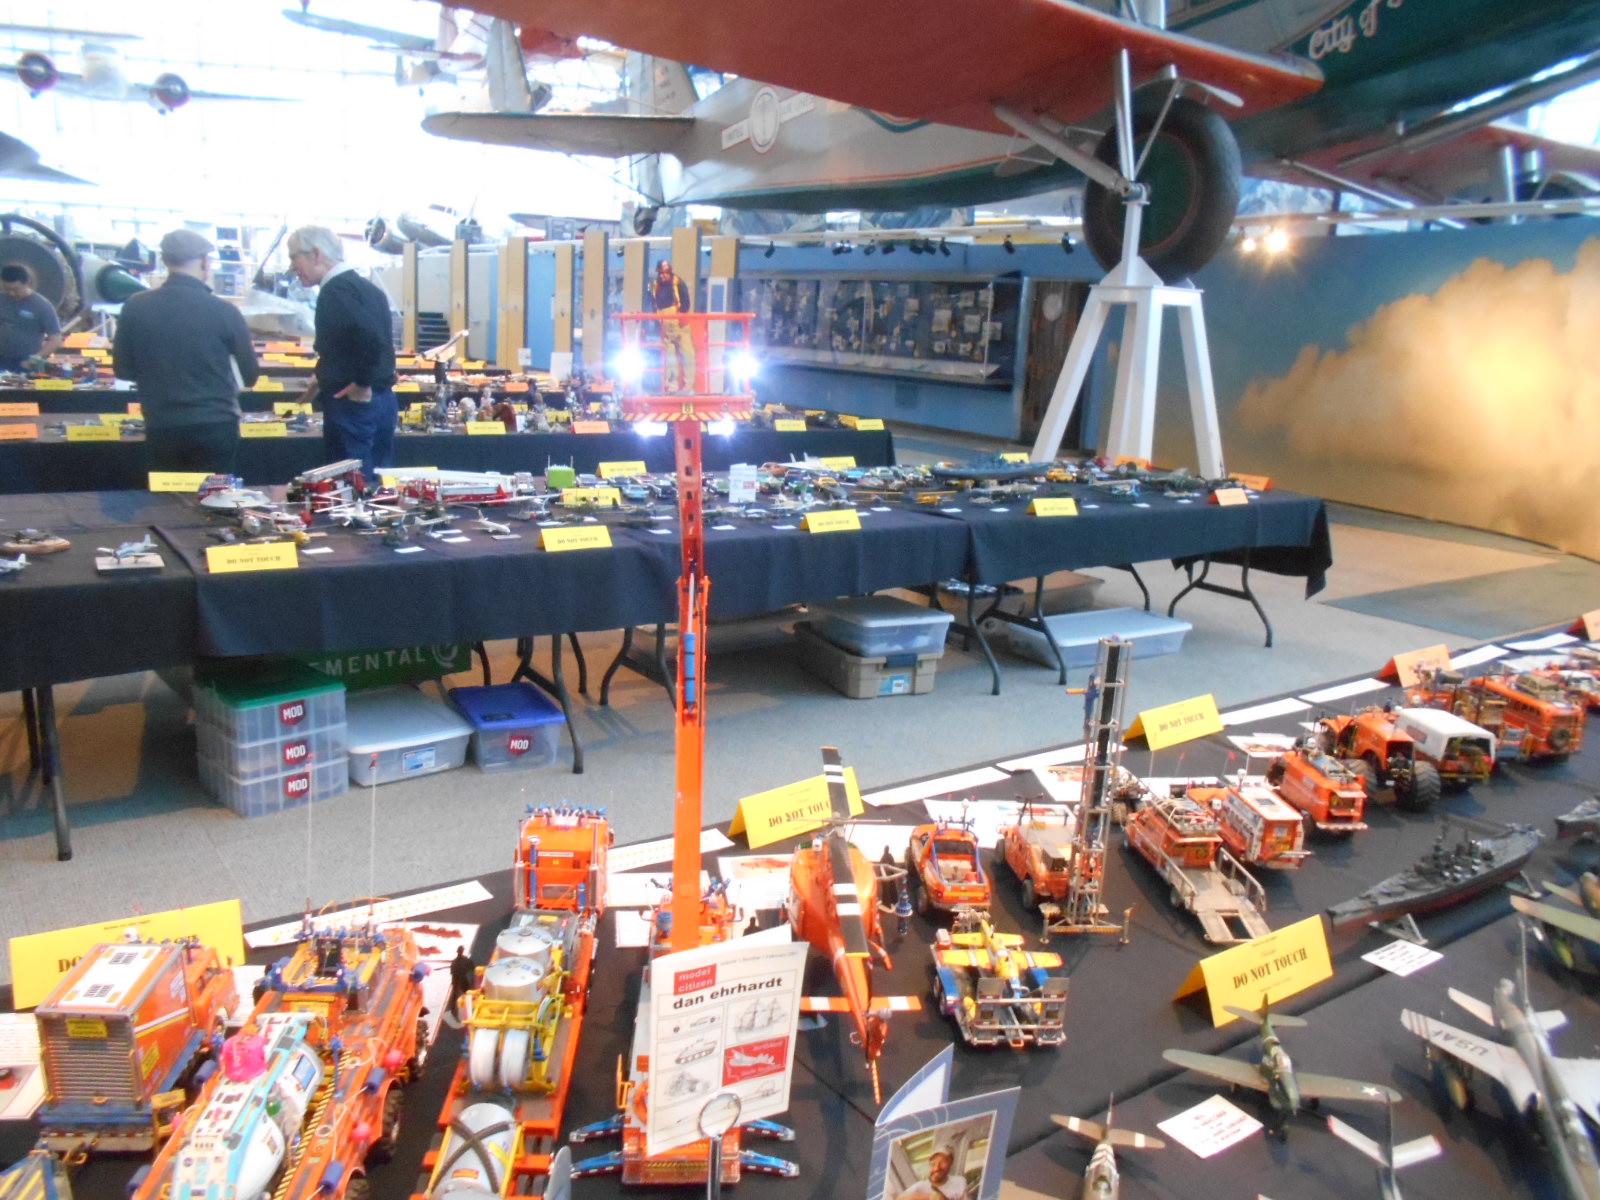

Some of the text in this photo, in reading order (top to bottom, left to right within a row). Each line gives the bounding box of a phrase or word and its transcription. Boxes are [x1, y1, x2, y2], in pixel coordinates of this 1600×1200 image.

[1308, 14, 1358, 59] City
[283, 704, 304, 720] MOD
[1158, 712, 1205, 731] DO NOT TOUCH
[285, 744, 306, 760] MOD
[510, 738, 529, 750] MOD
[288, 778, 308, 792] MOD
[768, 813, 783, 828] DO
[785, 807, 805, 823] NOT
[679, 966, 712, 981] model
[1232, 972, 1248, 989] DO
[1250, 962, 1271, 980] NOT
[1274, 947, 1308, 972] TOUCH
[677, 977, 714, 993] citizen
[673, 977, 783, 1010] dan ehrhardt
